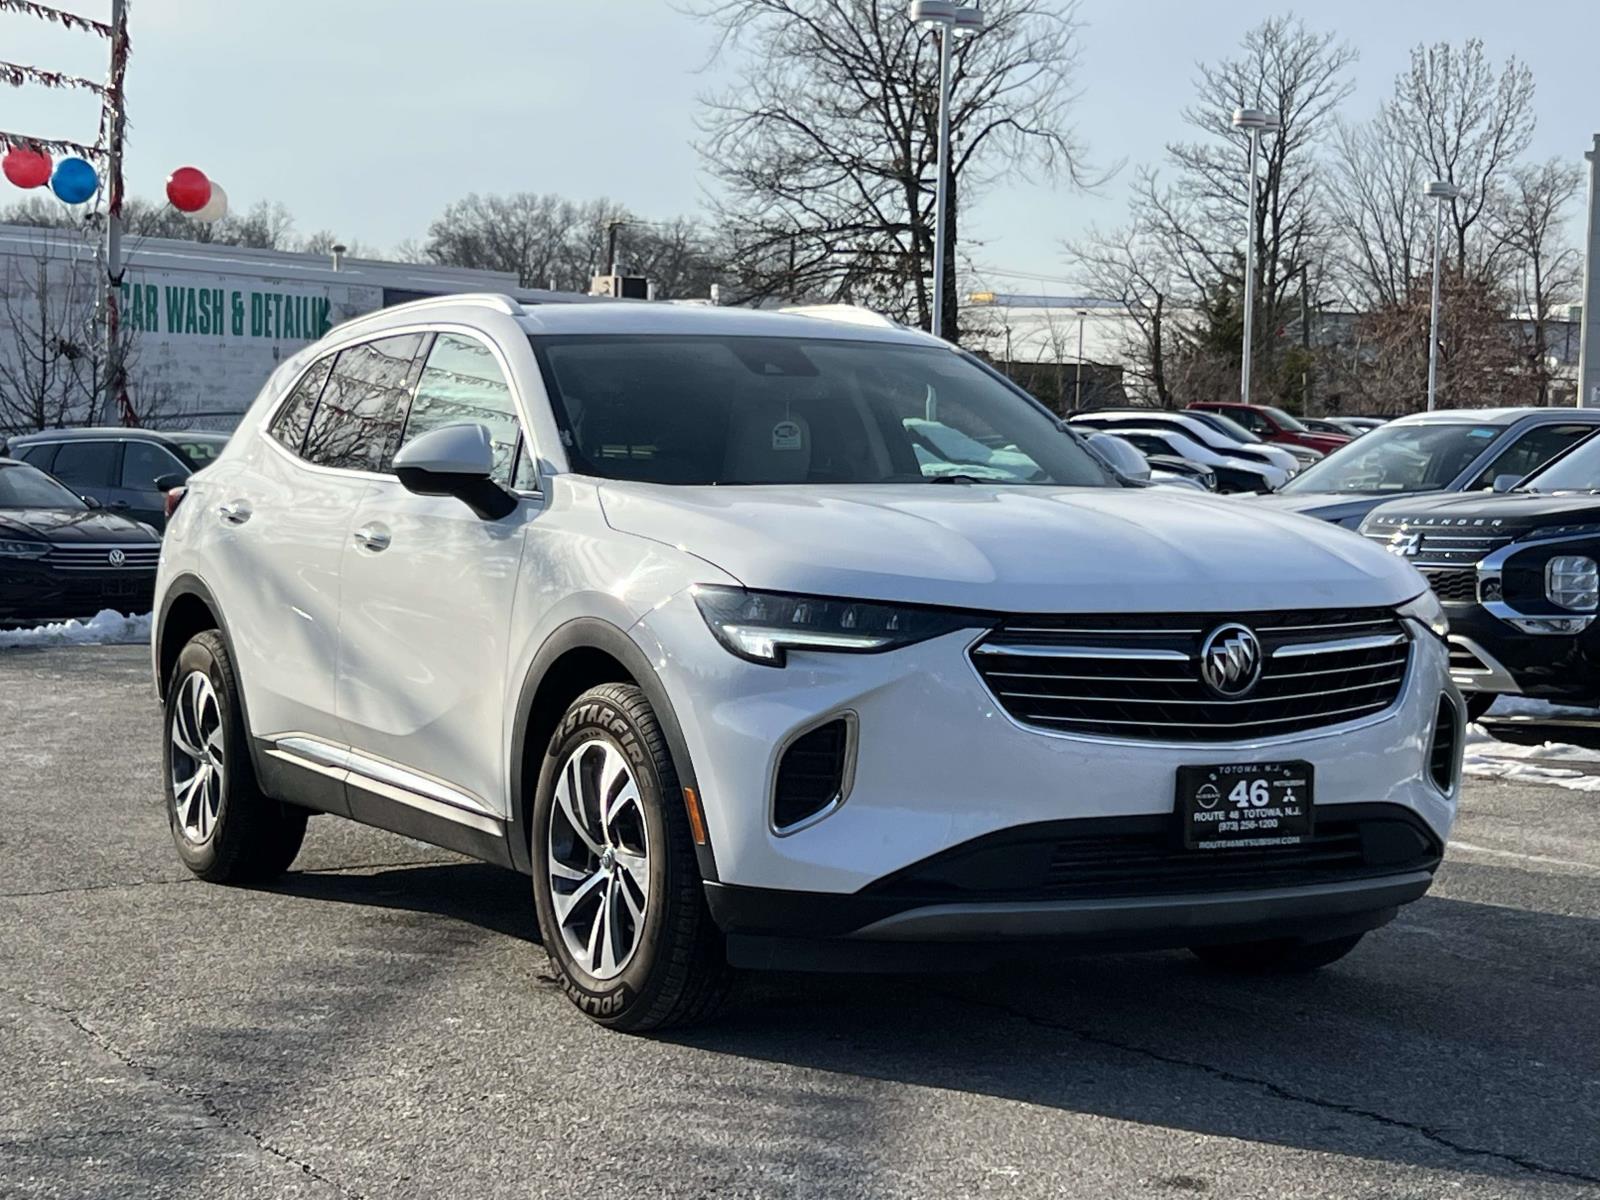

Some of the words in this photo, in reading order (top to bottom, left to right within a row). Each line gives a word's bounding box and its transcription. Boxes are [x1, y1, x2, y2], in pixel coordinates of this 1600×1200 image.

[120, 282, 159, 333] CAR
[165, 286, 224, 336] WASH
[231, 291, 244, 336] &
[564, 703, 654, 788] STARFIRE
[1228, 779, 1270, 808] 46
[1194, 811, 1225, 822] ROUTE
